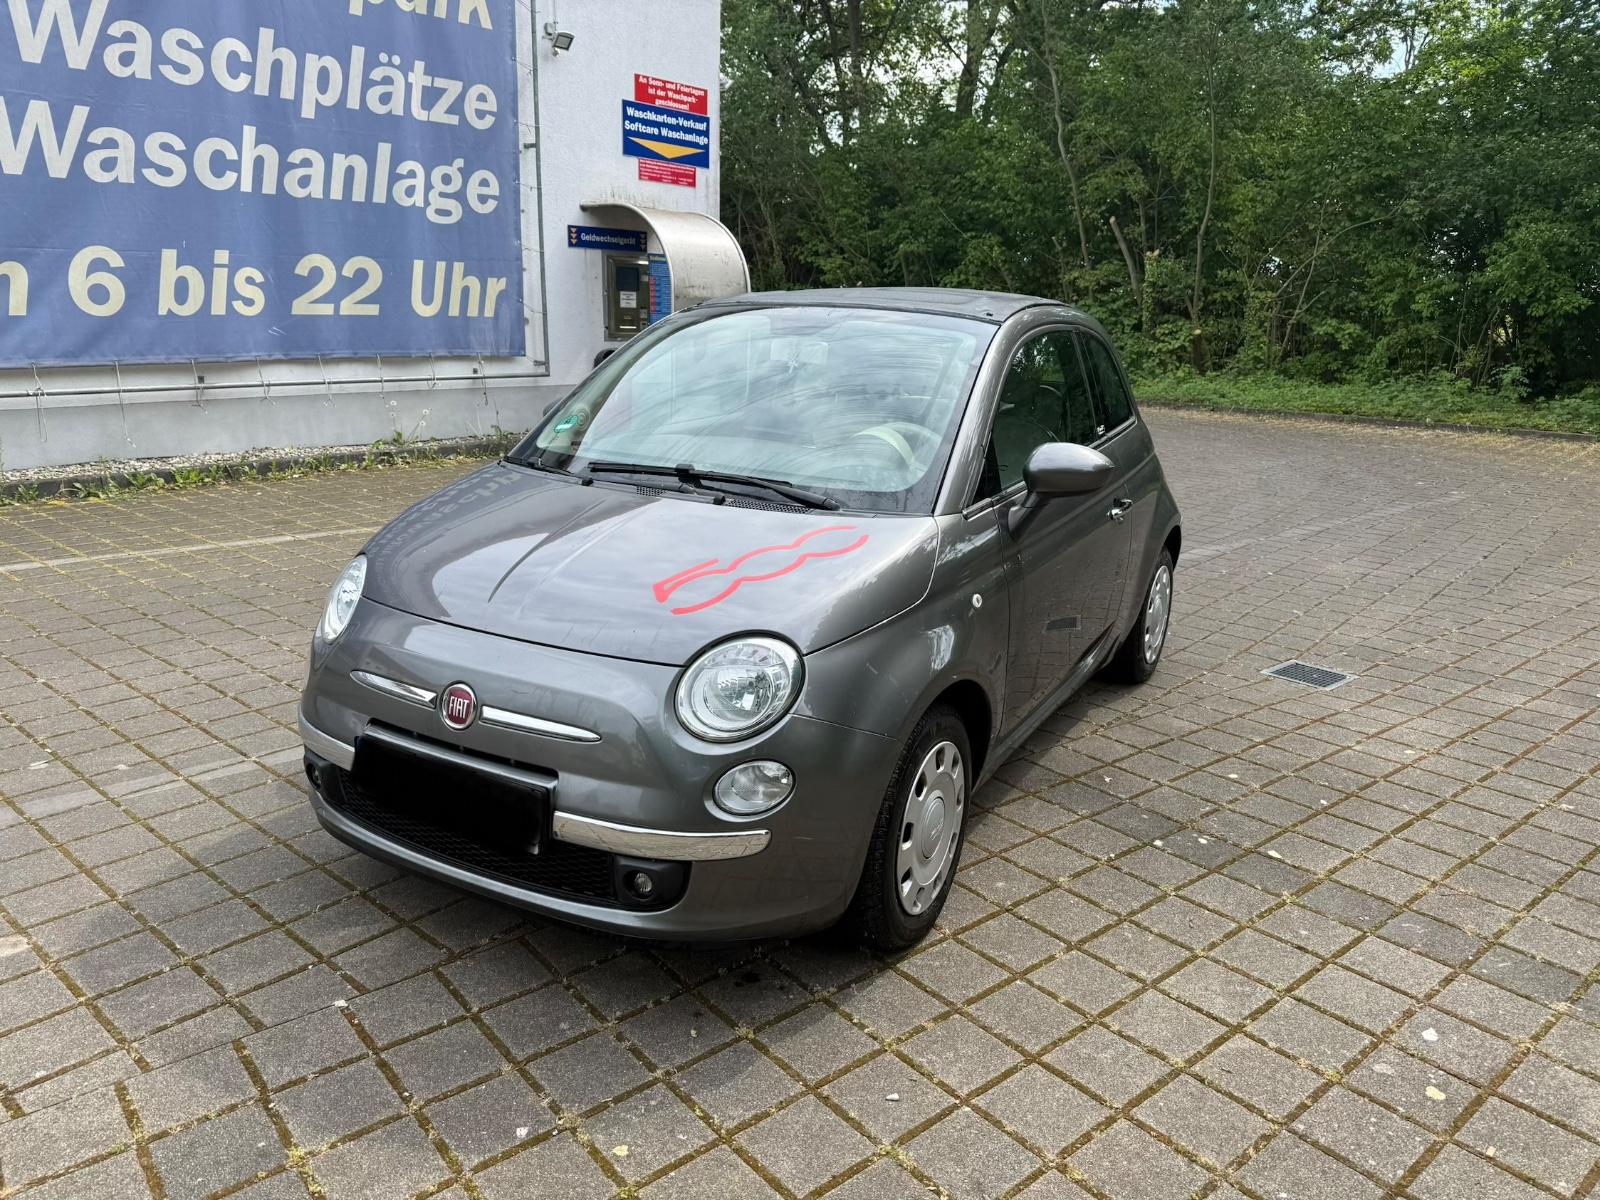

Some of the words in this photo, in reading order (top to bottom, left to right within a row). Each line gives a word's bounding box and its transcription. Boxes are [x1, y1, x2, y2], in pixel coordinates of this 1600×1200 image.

[7, 0, 498, 130] Waschplätze
[647, 86, 656, 95] ist
[656, 89, 666, 97] der
[665, 82, 676, 90] und
[626, 106, 707, 131] Waschkarten-Verkauf
[624, 120, 659, 135] Softcare
[660, 126, 709, 146] Waschanlage
[0, 95, 500, 225] Waschanlage
[67, 245, 126, 317] 6
[158, 248, 266, 316] bis
[291, 253, 383, 316] 22
[411, 259, 507, 318] Uhr
[448, 695, 470, 719] FIAT
